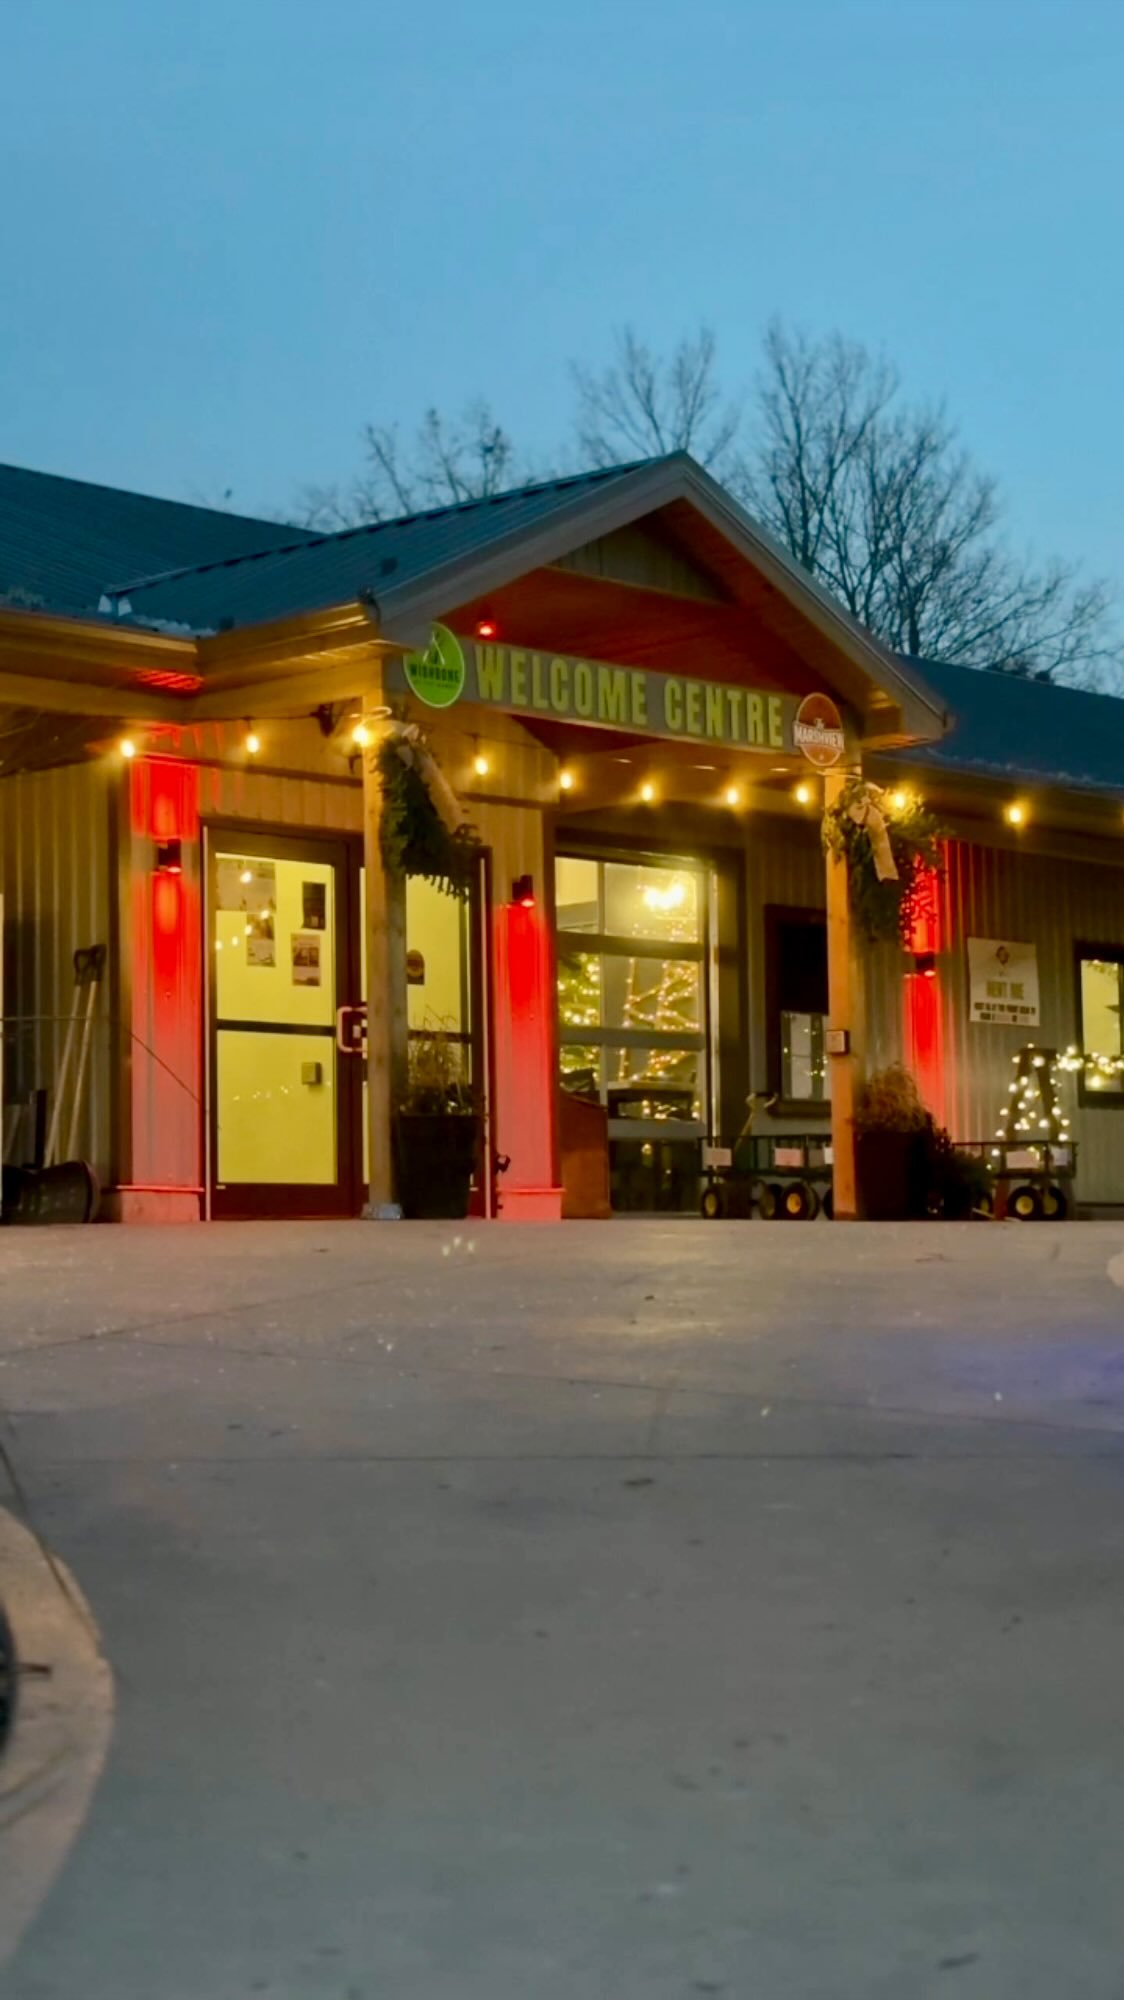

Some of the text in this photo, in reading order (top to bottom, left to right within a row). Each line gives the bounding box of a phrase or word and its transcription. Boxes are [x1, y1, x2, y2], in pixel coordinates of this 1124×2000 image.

[475, 645, 784, 748] WELCOME CENTRE
[793, 723, 844, 753] MARSHVIEW
